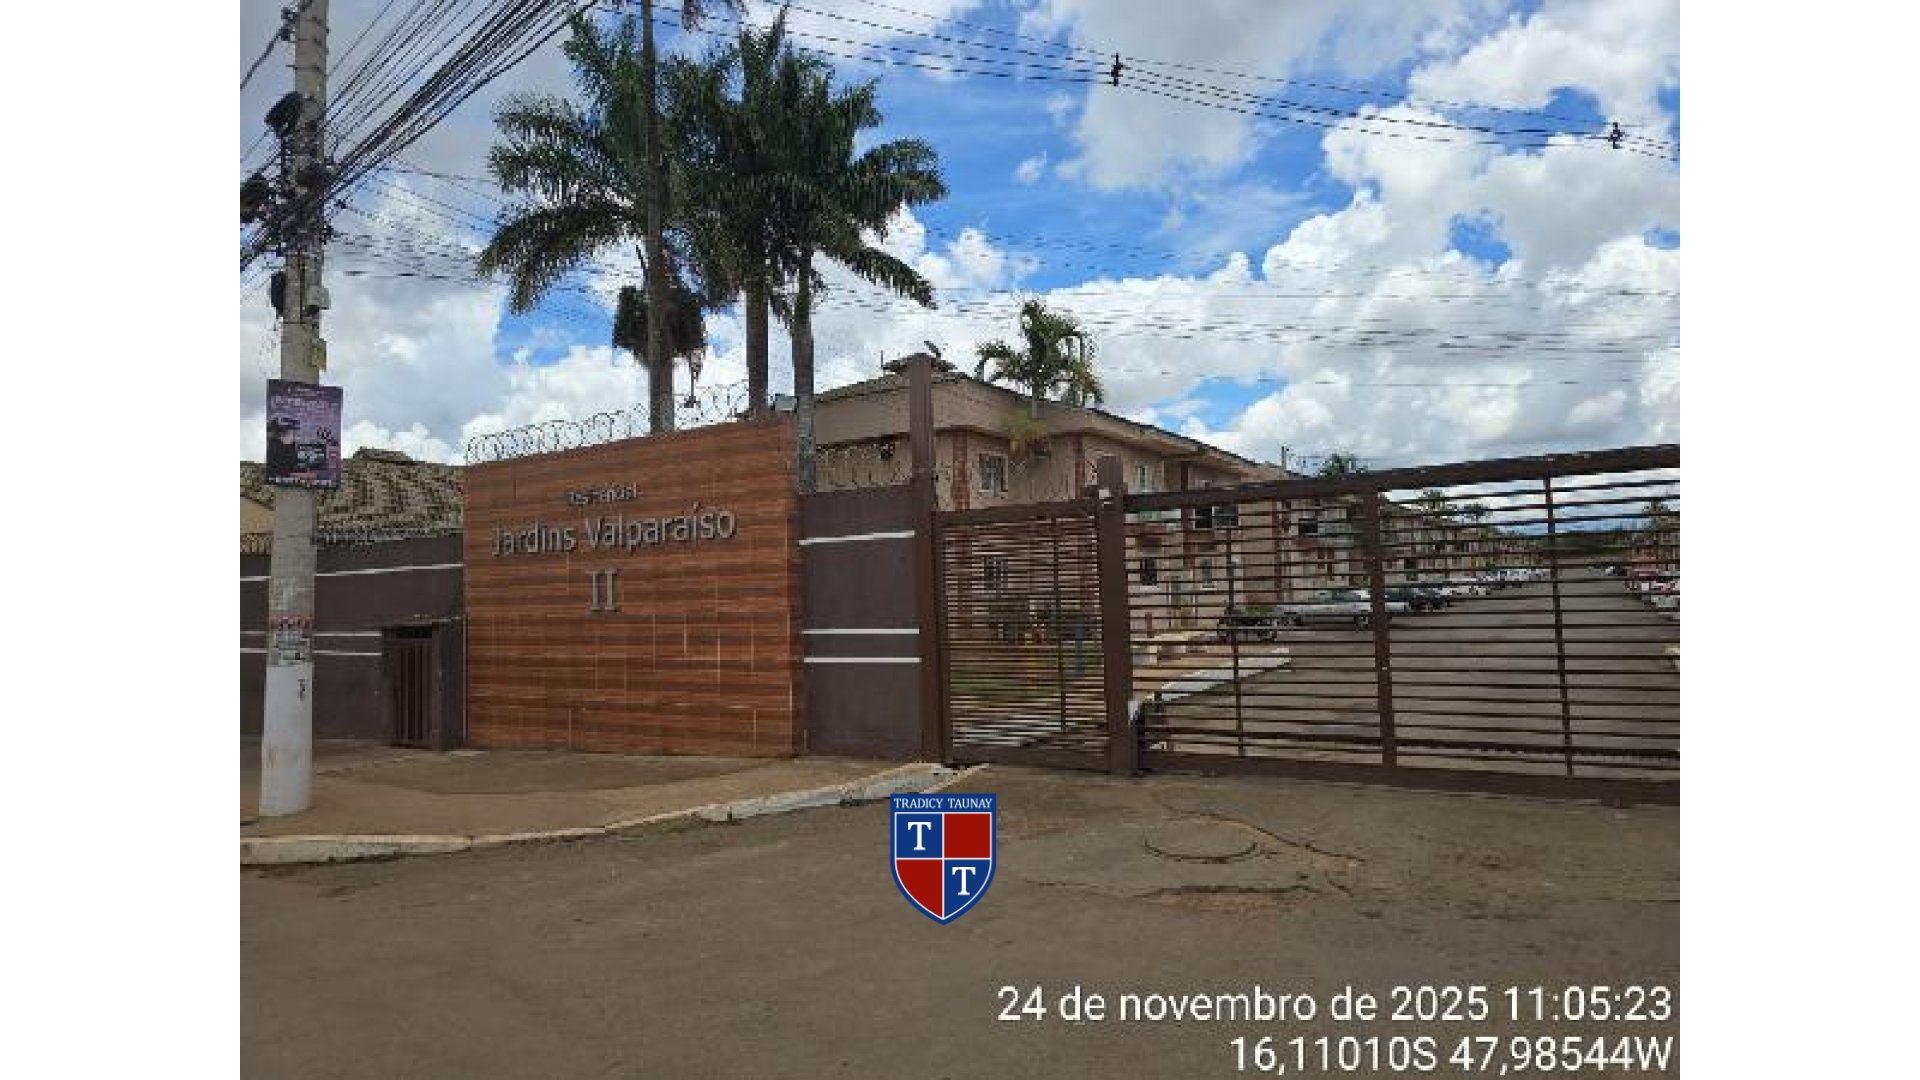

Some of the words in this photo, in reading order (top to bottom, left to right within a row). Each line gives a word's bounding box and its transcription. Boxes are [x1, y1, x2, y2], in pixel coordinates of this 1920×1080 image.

[491, 520, 577, 556] Jardins
[585, 501, 736, 551] Valparaíso
[584, 569, 617, 611] II
